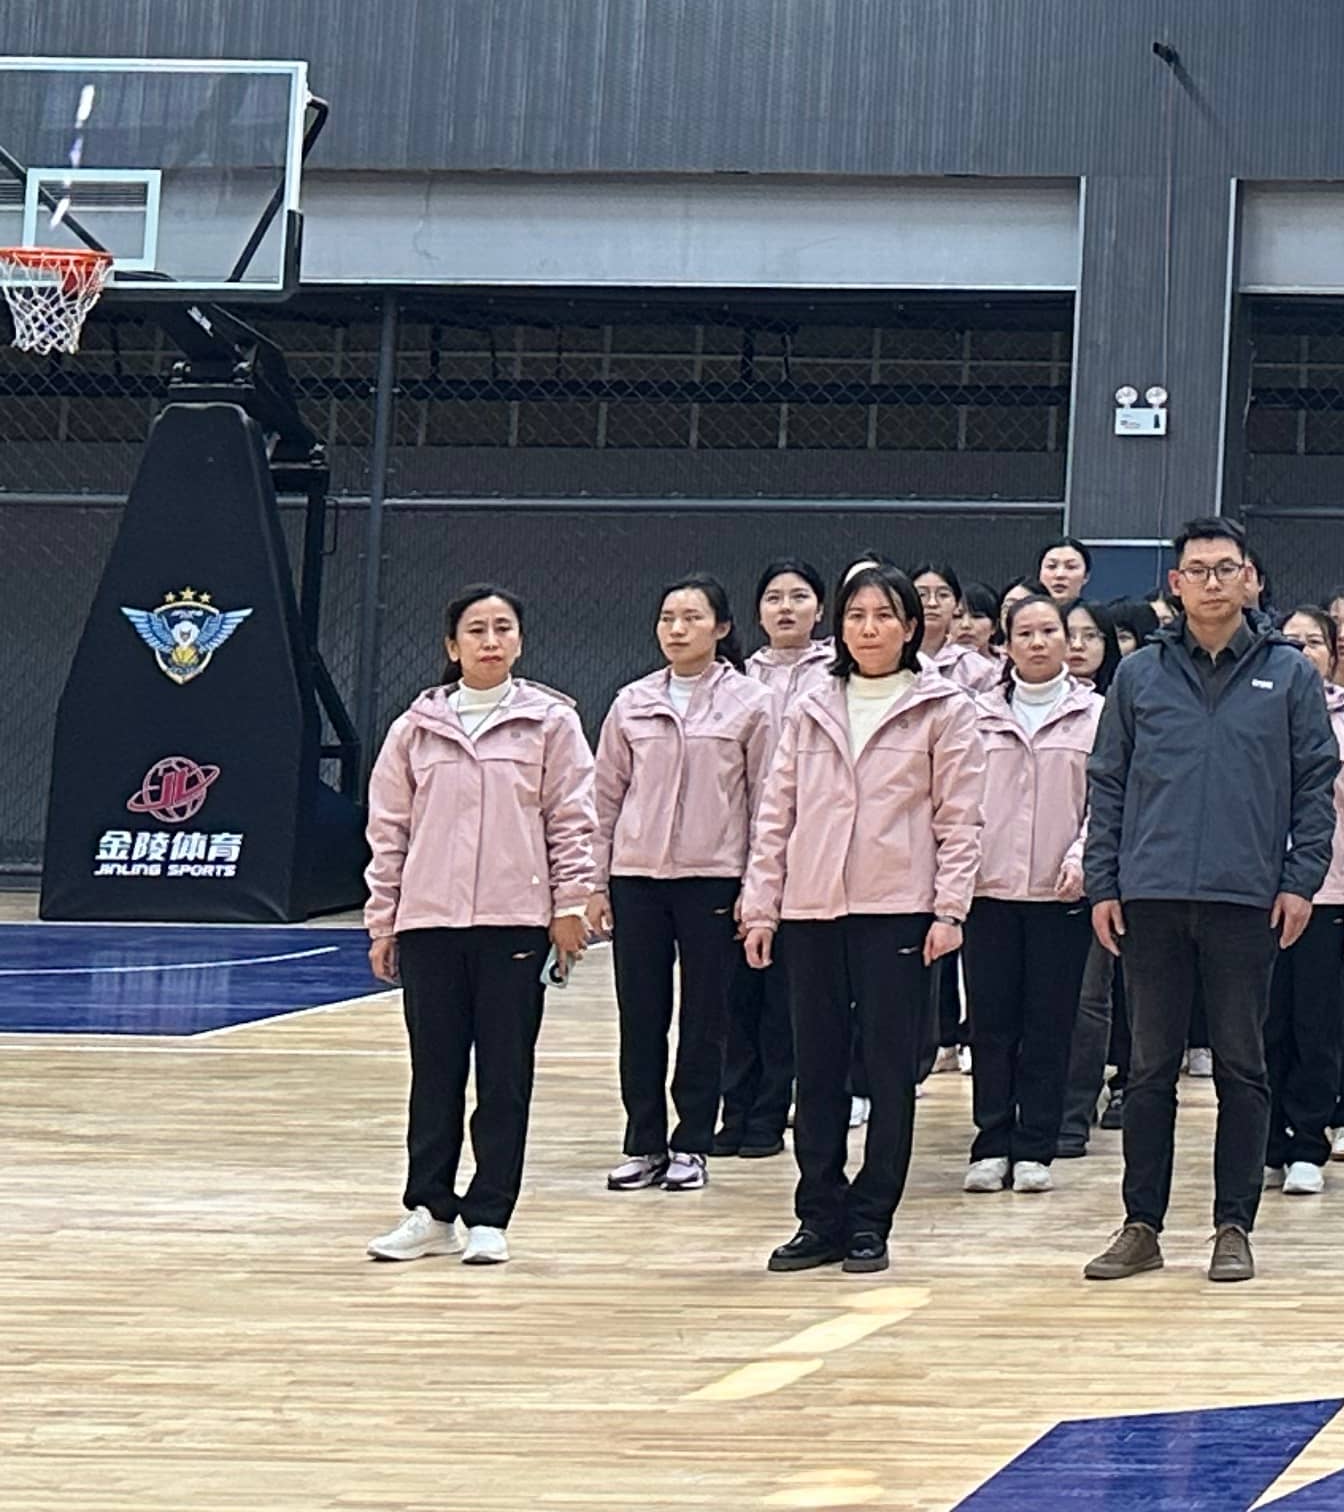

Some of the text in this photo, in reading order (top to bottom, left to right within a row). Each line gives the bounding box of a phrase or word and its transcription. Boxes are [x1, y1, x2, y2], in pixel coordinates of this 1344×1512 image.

[95, 830, 243, 861] 金陵体育
[167, 864, 237, 877] SPORTS
